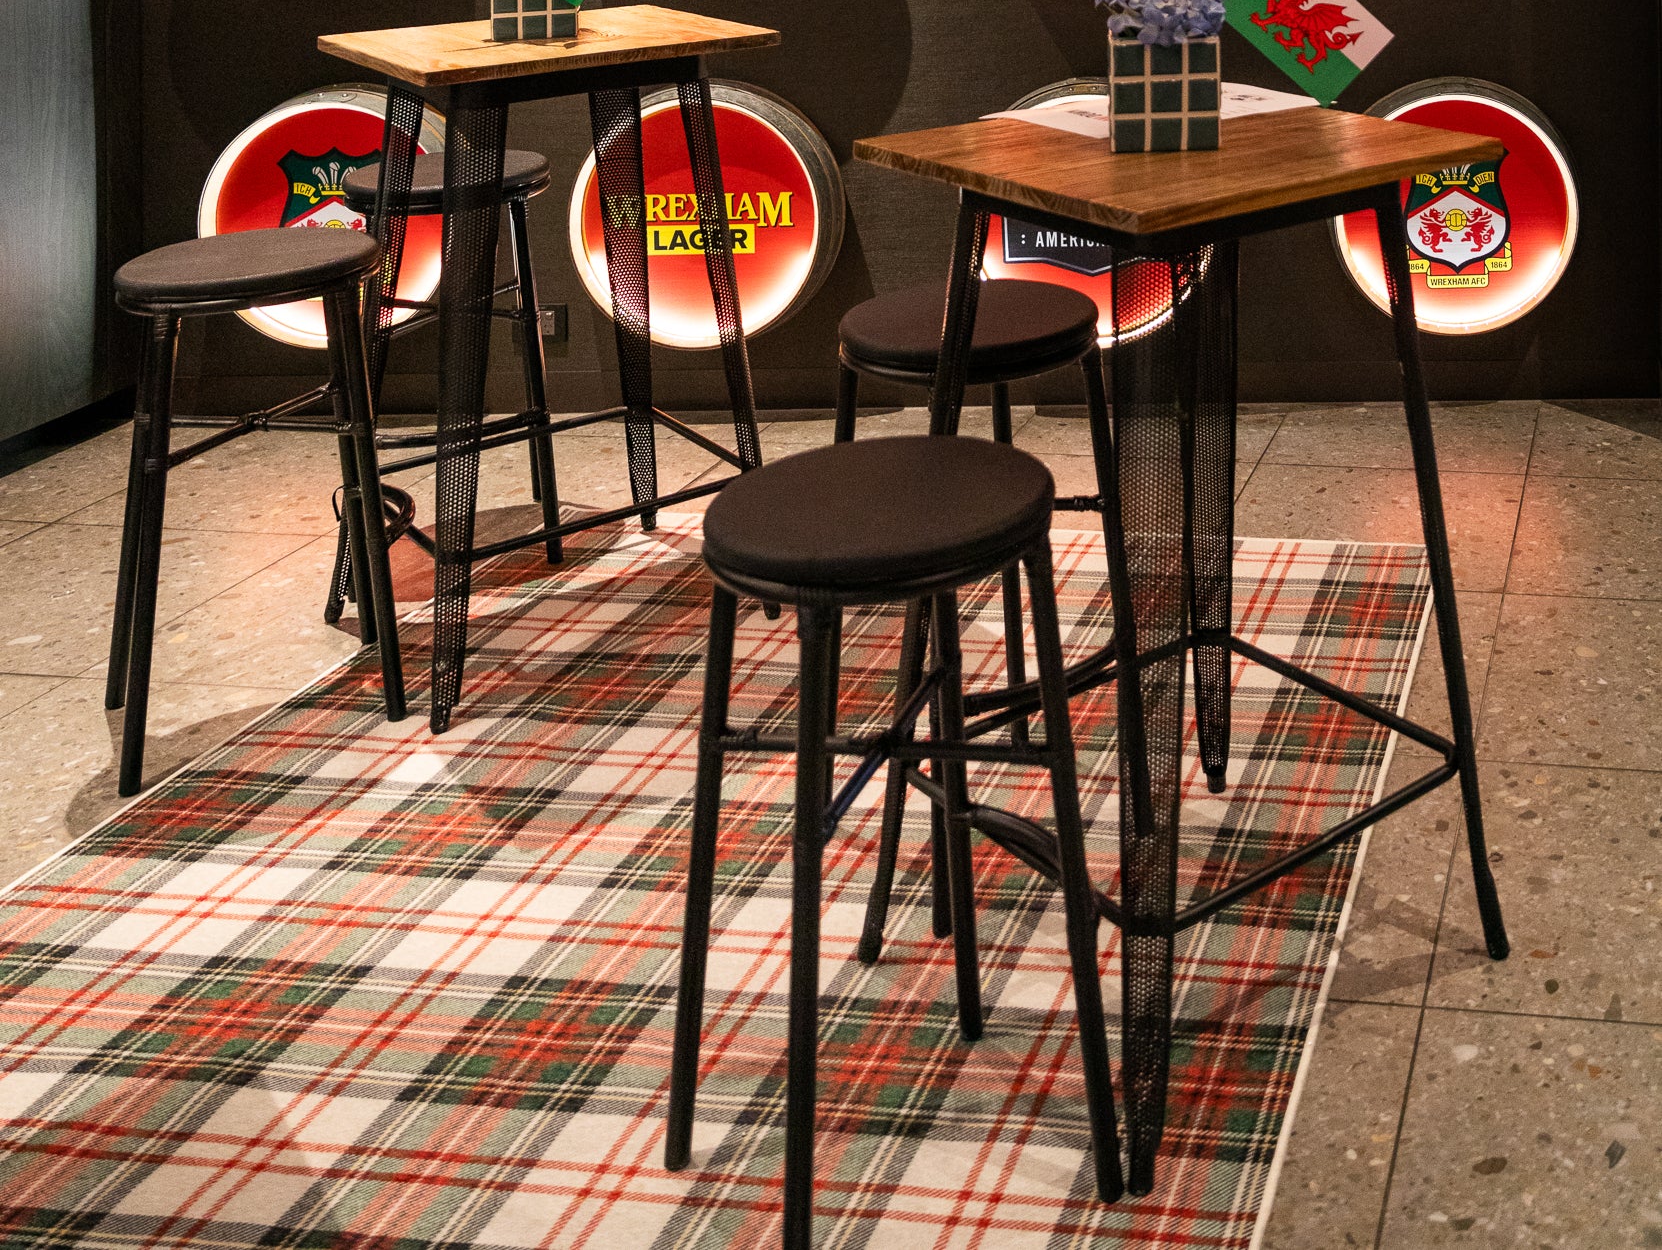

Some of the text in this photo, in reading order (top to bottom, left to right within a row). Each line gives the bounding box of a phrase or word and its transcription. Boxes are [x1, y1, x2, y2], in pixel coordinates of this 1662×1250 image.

[1475, 172, 1495, 185] DIEN
[295, 183, 312, 196] ICH
[652, 228, 749, 252] LAGR
[1035, 230, 1111, 248] AMERI
[1410, 262, 1425, 271] 864
[1490, 261, 1509, 269] 1864
[1430, 277, 1487, 287] WREXHAM AFC
